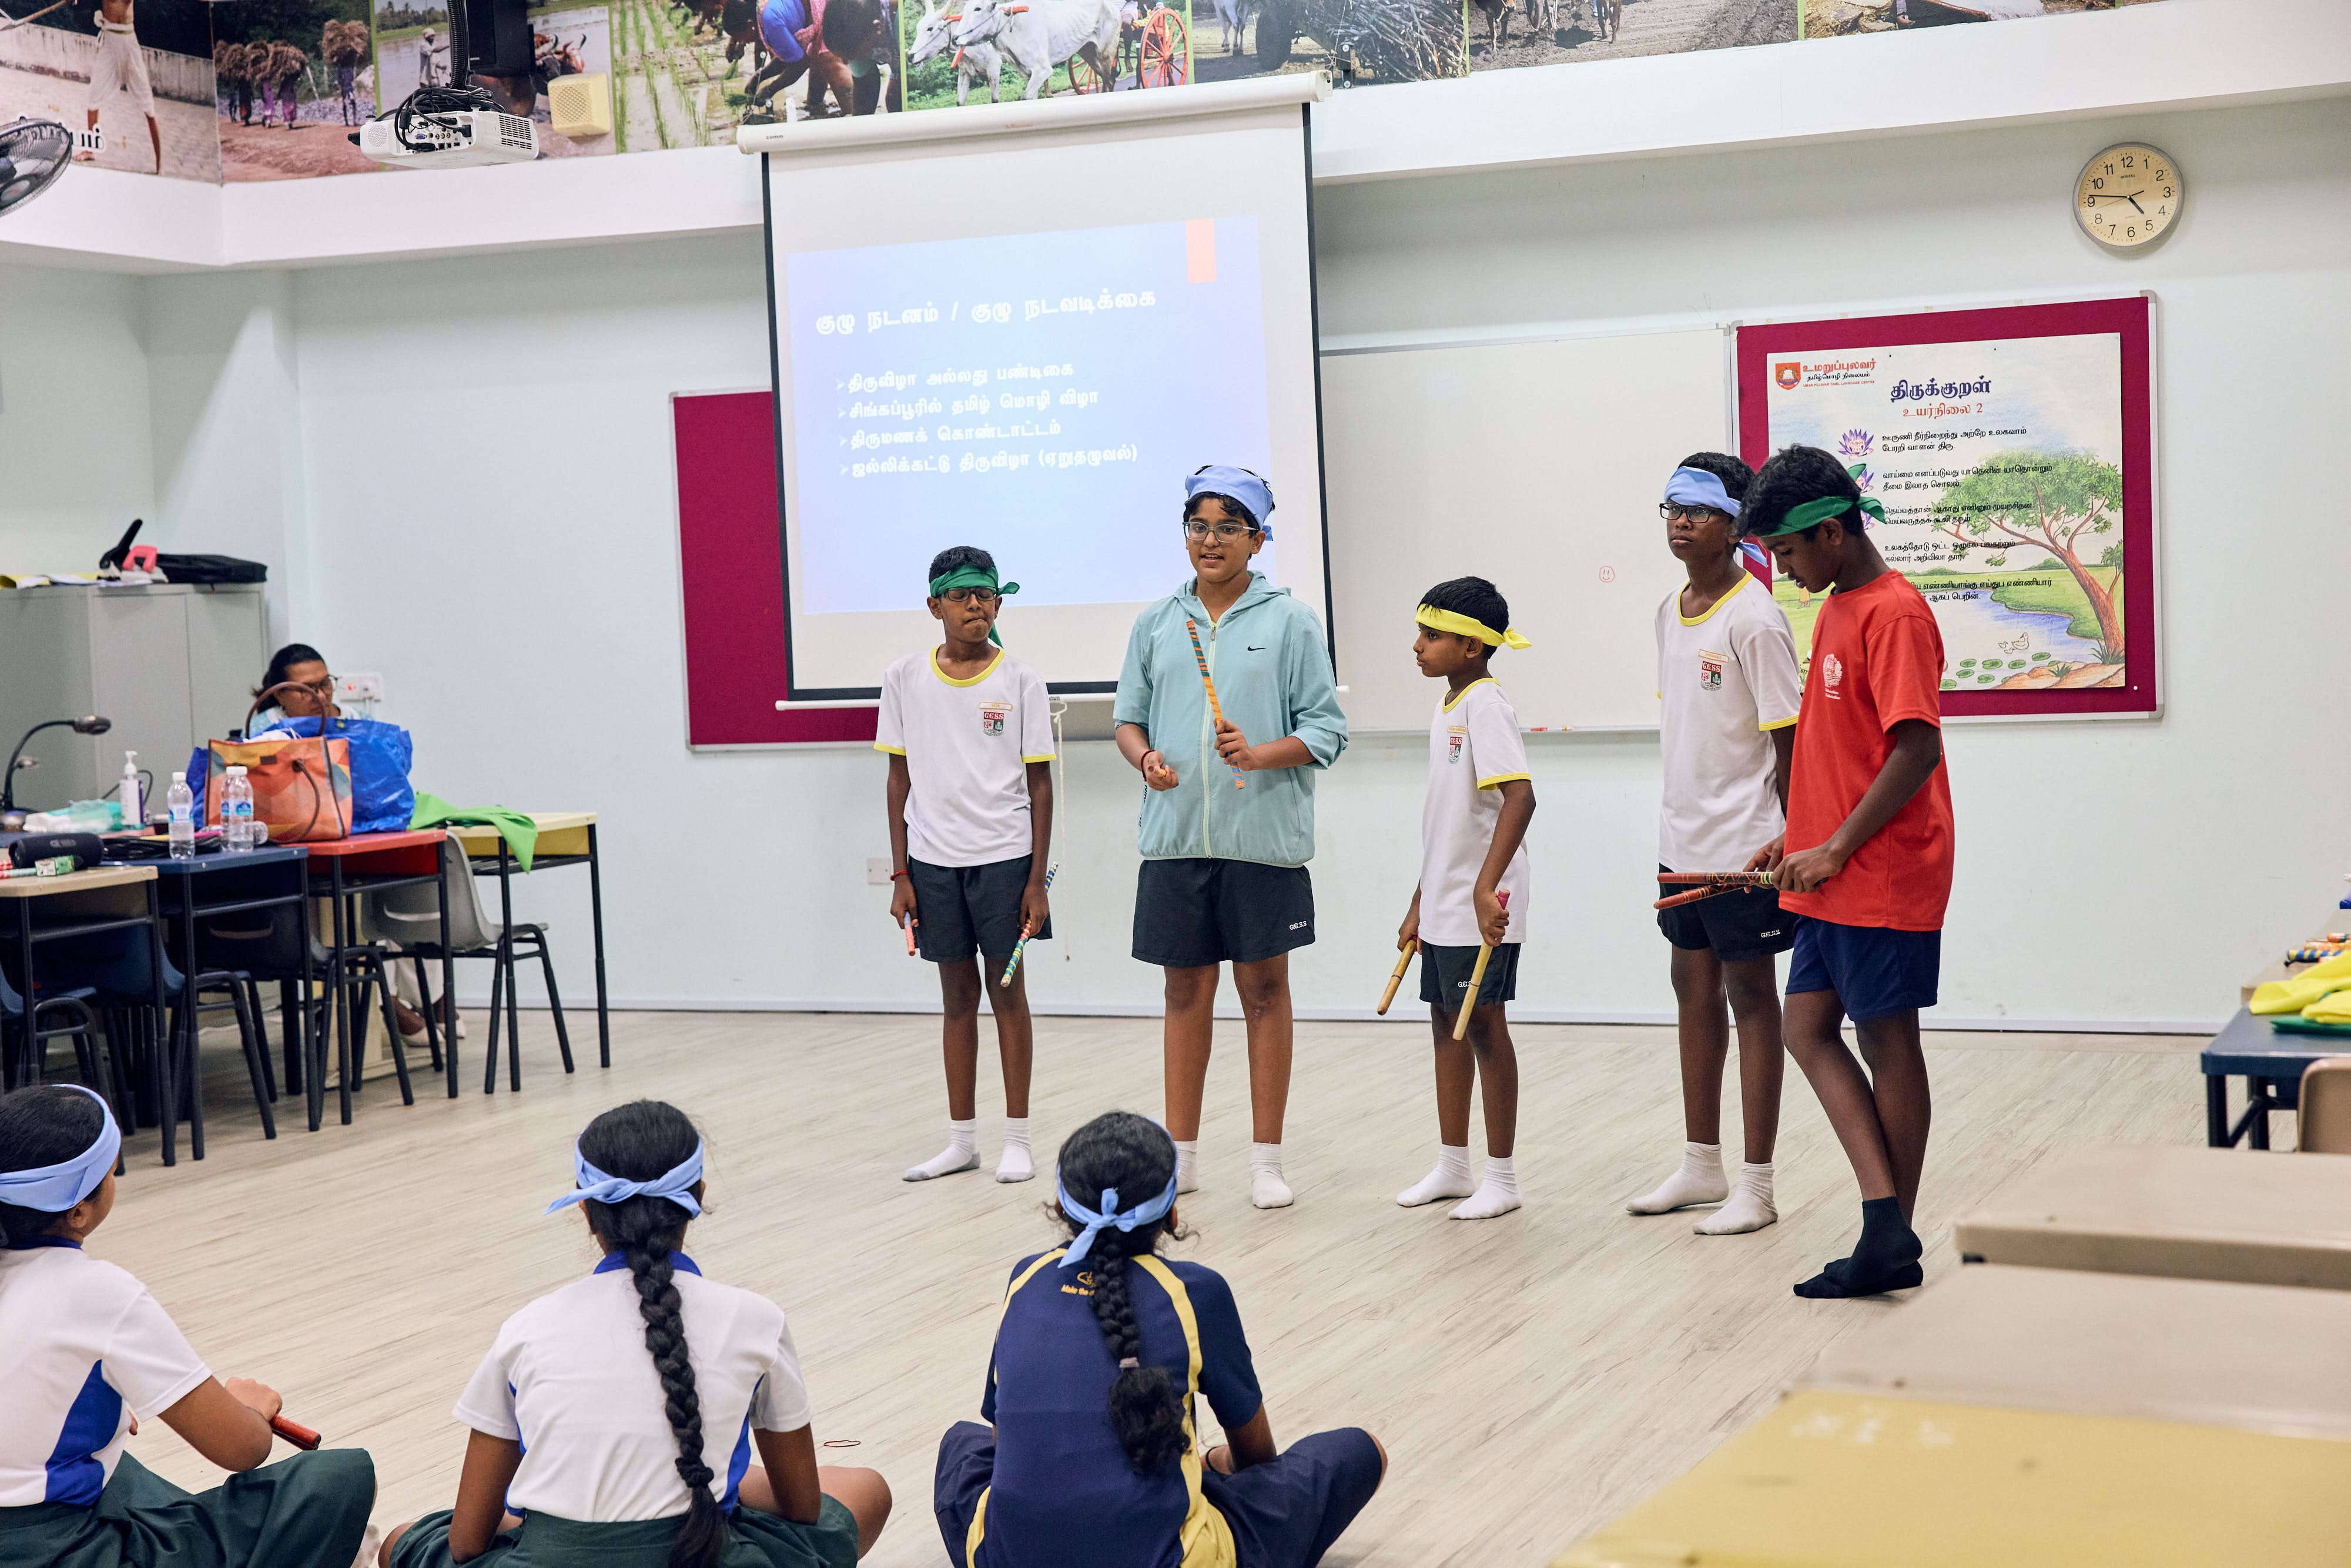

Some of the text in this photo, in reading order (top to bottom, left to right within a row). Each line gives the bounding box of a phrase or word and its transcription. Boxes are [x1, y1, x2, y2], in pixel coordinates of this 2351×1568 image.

[2121, 156, 2134, 168] 12
[2144, 158, 2148, 169] 1
[2104, 163, 2114, 175] 11
[2156, 169, 2164, 182] 2
[2091, 177, 2104, 190] 10
[2163, 186, 2171, 198] 3
[2087, 196, 2095, 207] 9
[2158, 205, 2165, 216] 4
[2095, 213, 2102, 224] 8
[2109, 224, 2116, 236] 7
[2145, 220, 2154, 230] 5
[2127, 227, 2135, 237] 6
[816, 287, 1156, 335] குழு நடனம் / குழு நடவடிக்கை
[1803, 358, 1876, 373] உமறுப்புலவர்
[848, 363, 1074, 394] திருவிழா அல்லது பண்டிகை
[1842, 371, 1870, 380] நிலையம்
[1890, 375, 1991, 403] திருக்குறள்
[849, 388, 1099, 420] சிங்கப்பூரில் தமிழ் மொழி விழா
[1903, 403, 1982, 419] உயர்நிலை 2
[851, 418, 1061, 450] திருமணக் கொண்டாட்டம்
[1882, 426, 2027, 442] ஊருணி நீர்நிறைந்து அற்றே உலகவாம்
[1882, 443, 1905, 453] பேரறி
[852, 454, 950, 478] ஜல்லிக்கட்டு
[959, 451, 1030, 473] திருவிழா
[1883, 463, 2052, 478] வாய்மை எனப்படுவது யாதெனின் யாதொன்றும்
[1883, 482, 1902, 492] தீமை
[1904, 481, 1928, 491] இலாத
[1884, 505, 1931, 515] தெய்வத்தான்
[1934, 505, 1959, 514] ஆகாது
[1885, 542, 1930, 552] உலகத்தோடு
[1932, 541, 1950, 551] ஒட்ட
[1885, 554, 1911, 563] கல்லார்
[1914, 552, 1945, 563] அறிவிலா
[2007, 577, 2052, 587] எண்ணியார்
[1929, 592, 1950, 602] ஆகப்
